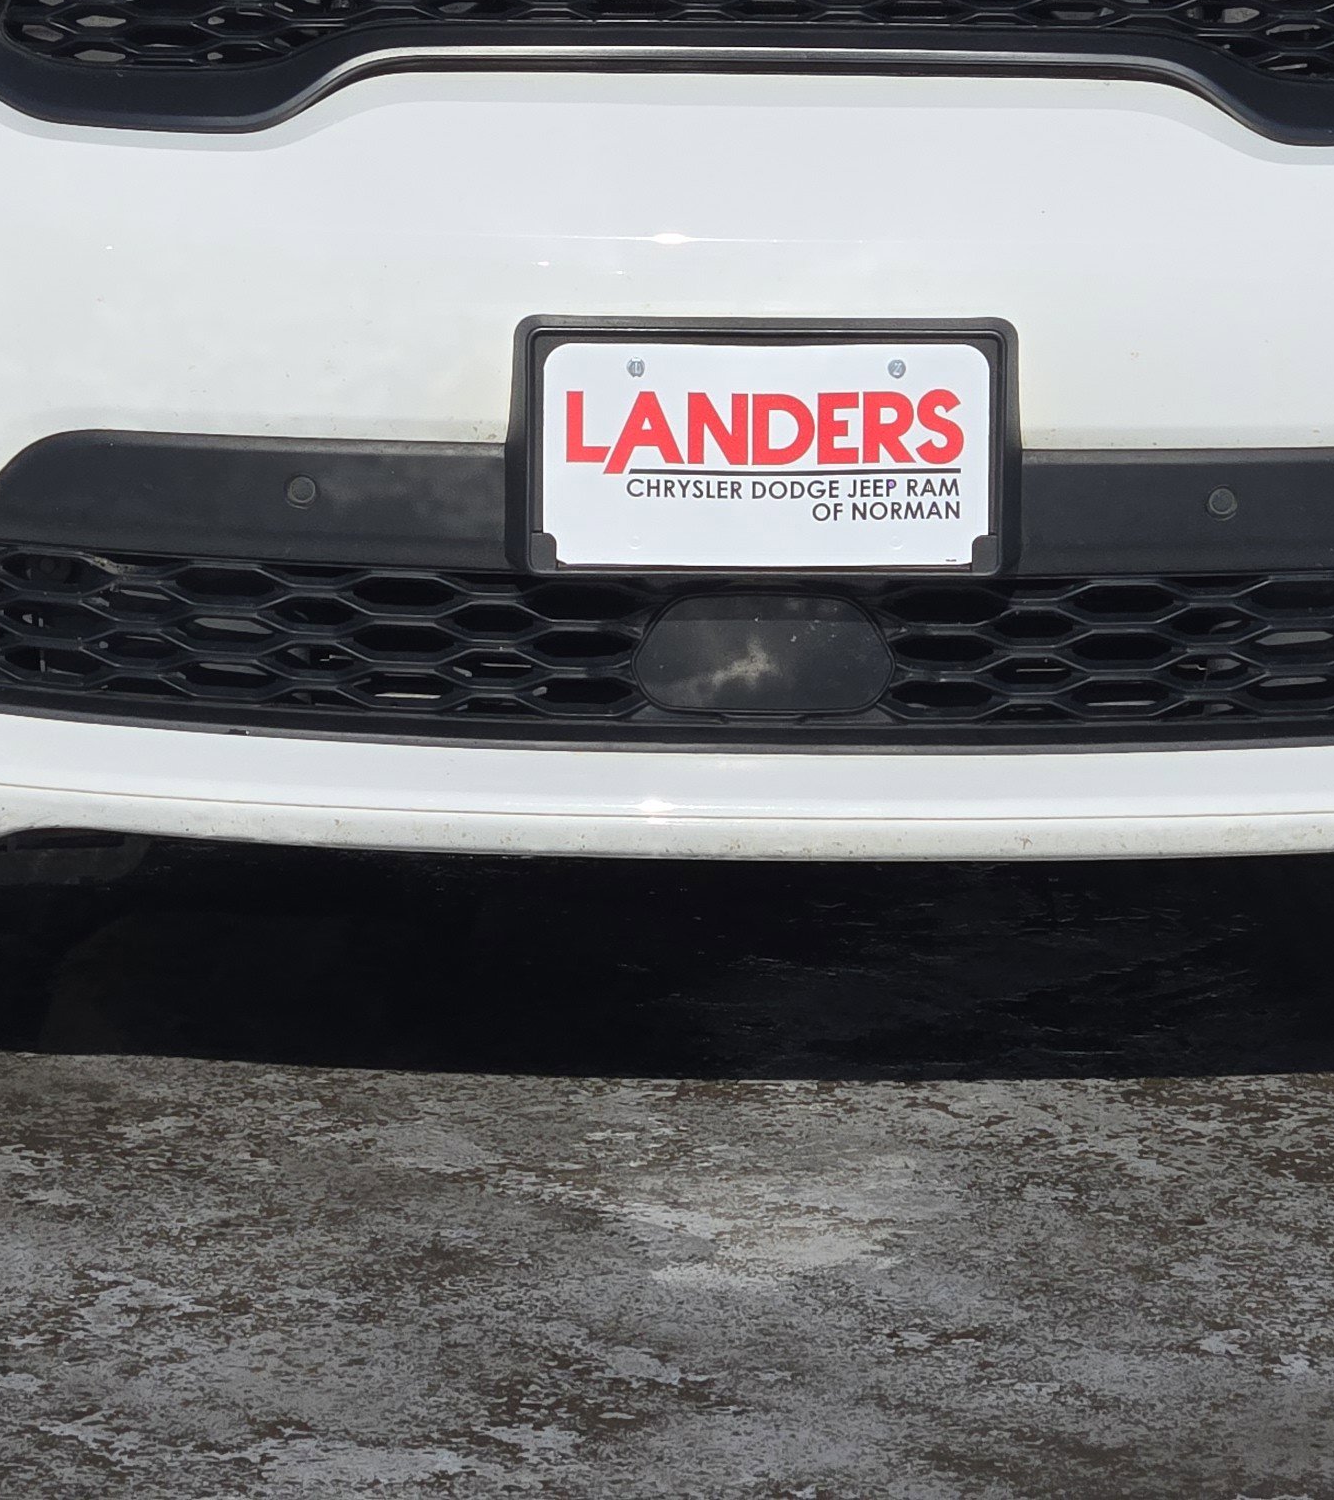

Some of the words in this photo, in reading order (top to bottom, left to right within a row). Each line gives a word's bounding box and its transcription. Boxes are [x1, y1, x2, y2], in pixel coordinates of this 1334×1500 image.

[566, 389, 965, 474] LANDERS
[626, 478, 742, 499] CHRYSLER
[751, 479, 840, 500] DODGE
[847, 479, 896, 499] JEEP
[906, 478, 960, 497] RAM
[812, 503, 845, 522] OF
[852, 501, 961, 521] NORMAN
